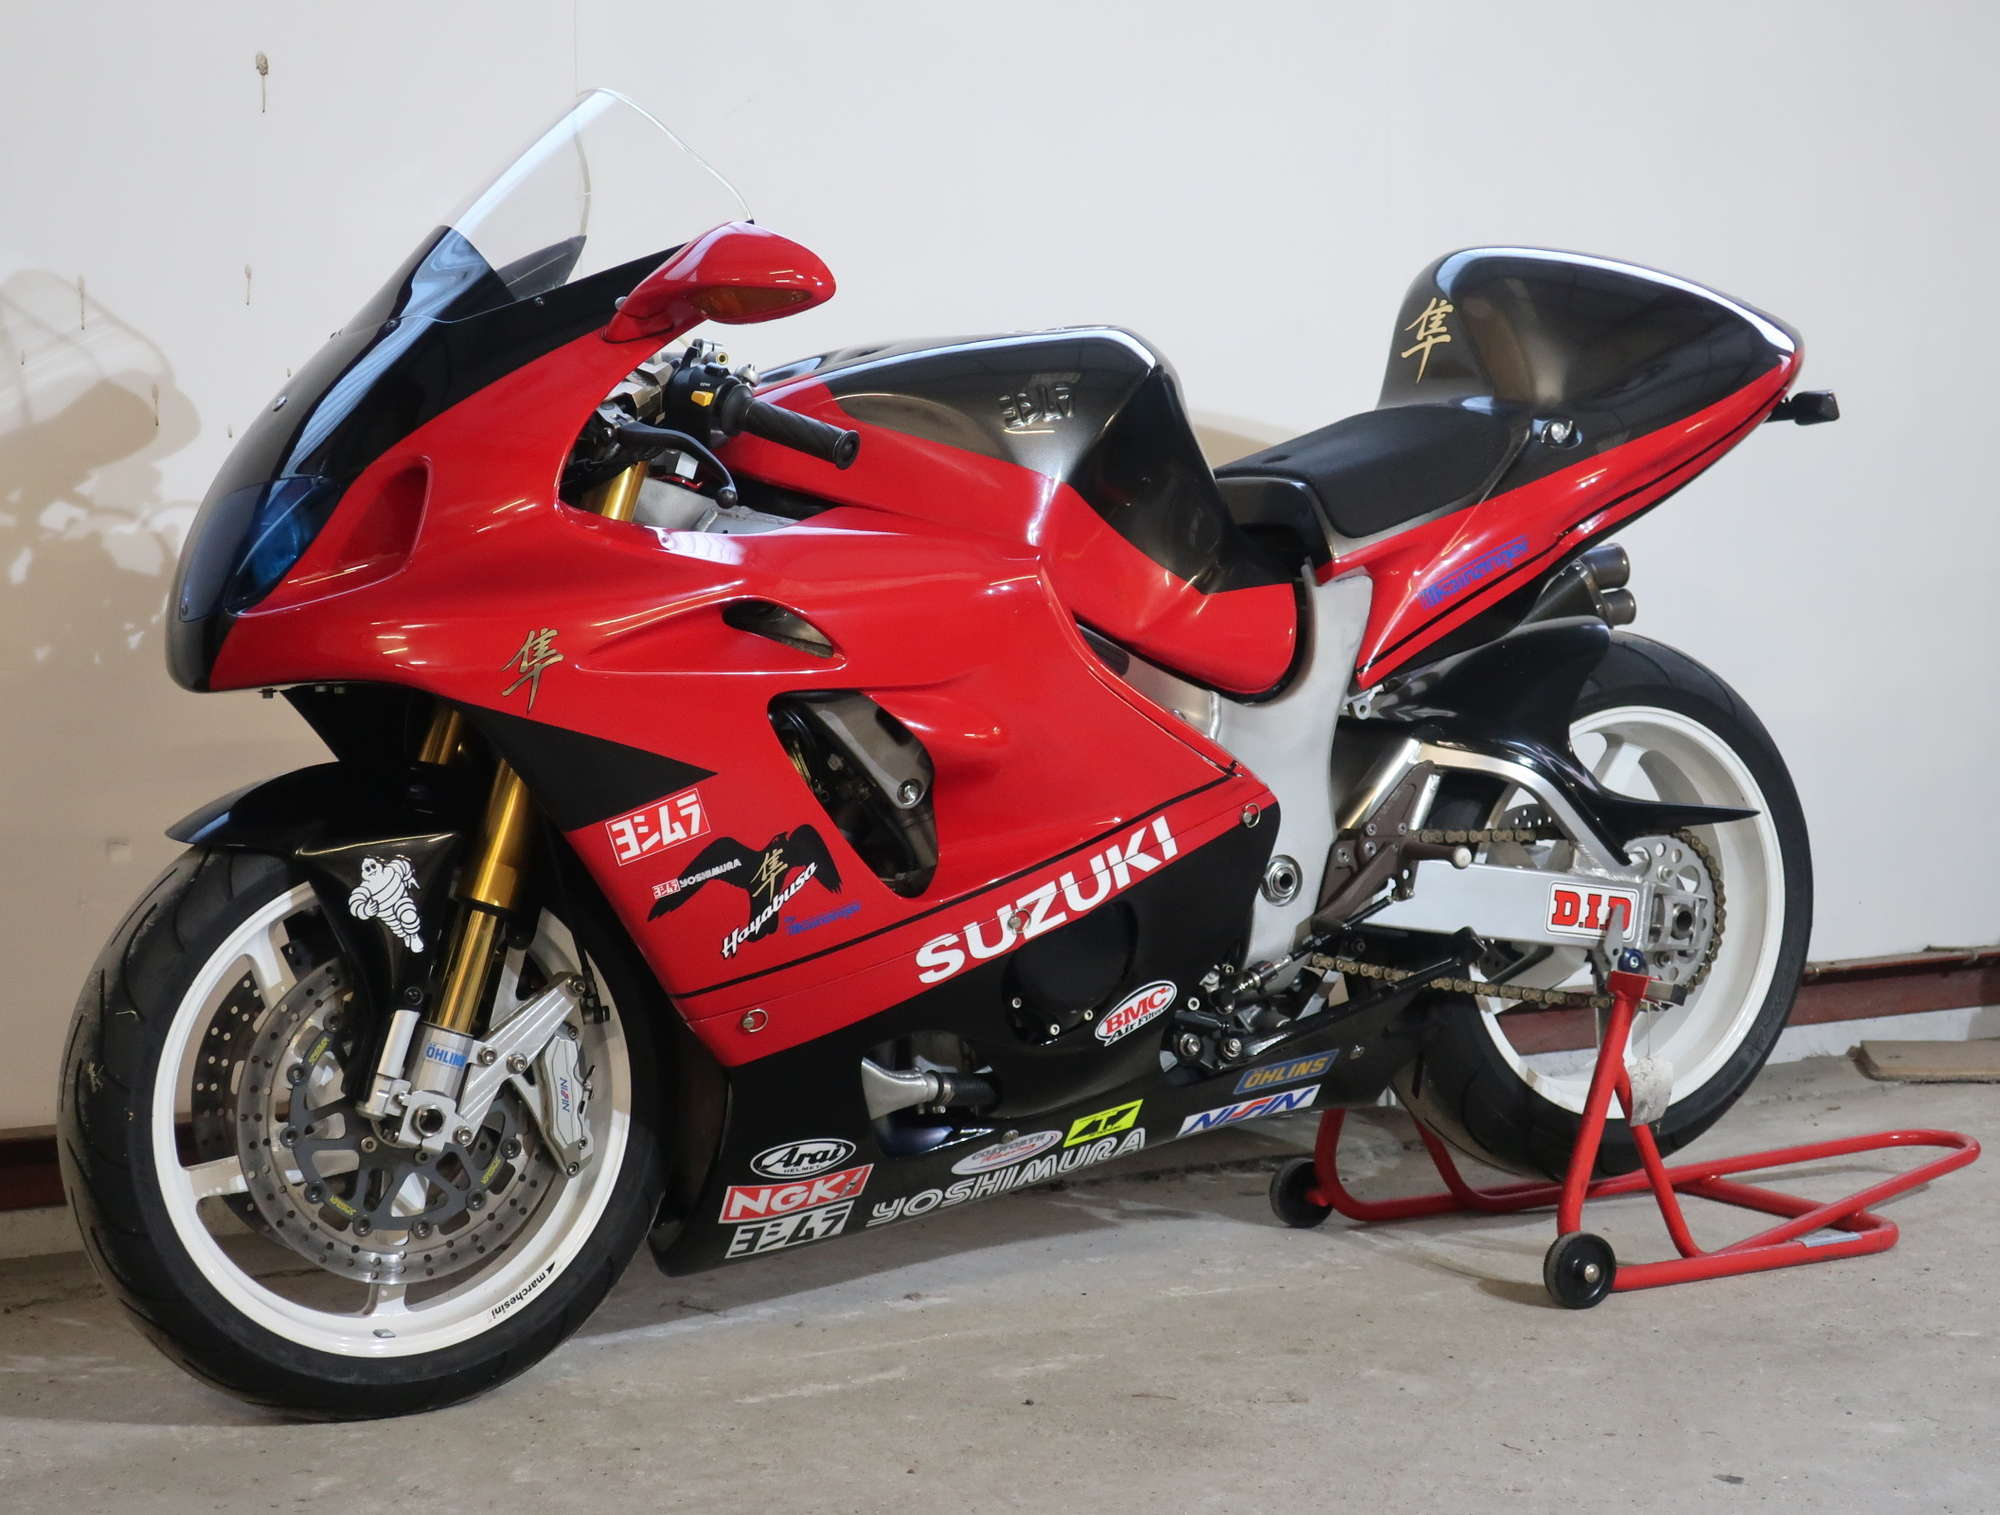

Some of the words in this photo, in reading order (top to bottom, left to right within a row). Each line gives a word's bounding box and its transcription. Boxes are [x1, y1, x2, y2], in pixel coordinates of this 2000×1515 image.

[1402, 297, 1454, 384] 隼
[501, 627, 564, 714] 隼
[610, 793, 702, 862] ヨシムラ
[680, 858, 742, 889] YOSHIMURA
[751, 848, 788, 900] 隼
[721, 861, 817, 959] Hayabusa
[915, 815, 1178, 984] SUZUKI
[1105, 987, 1168, 1034] BMC
[1109, 1021, 1136, 1042] Air
[1245, 1056, 1329, 1089] ÖHLINS
[759, 1142, 846, 1170] Arai
[866, 1127, 1147, 1227] YOSHIMURA
[729, 1174, 846, 1218] NGK
[491, 1272, 547, 1319] marchesini
